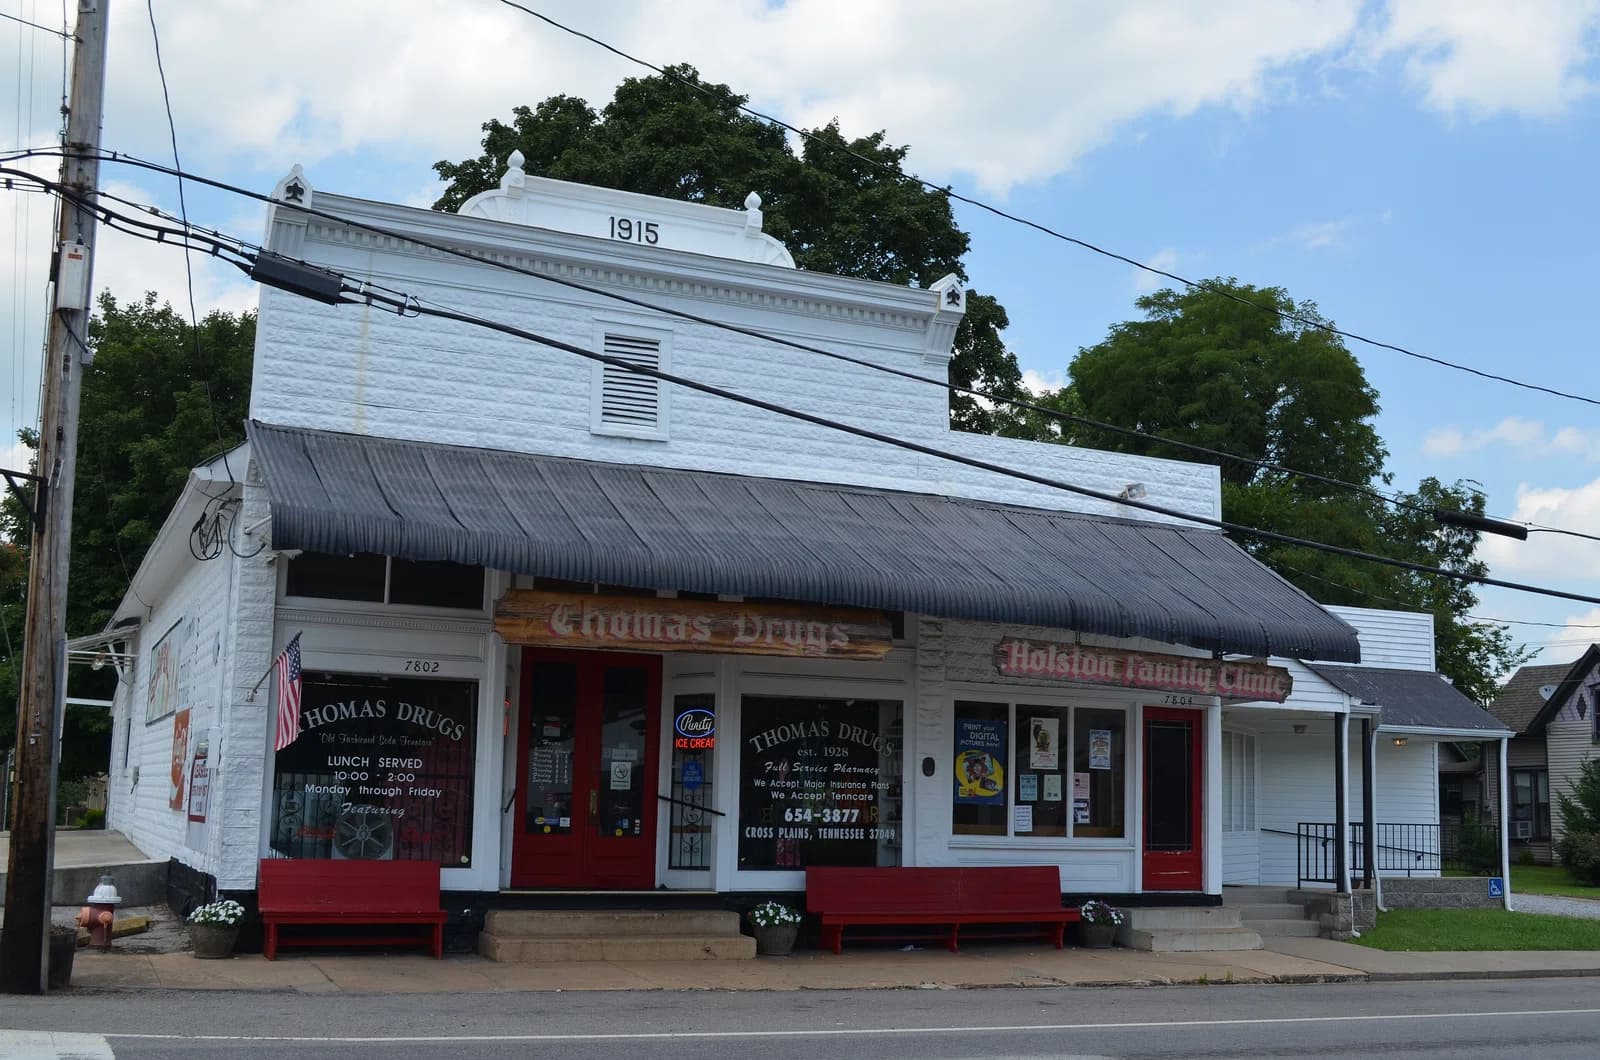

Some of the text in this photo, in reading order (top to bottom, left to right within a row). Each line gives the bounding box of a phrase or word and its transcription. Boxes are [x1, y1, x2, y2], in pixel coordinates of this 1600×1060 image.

[608, 216, 659, 244] 1915
[545, 602, 850, 655] Thomas Drugs
[405, 660, 440, 673] 7802
[1001, 642, 1287, 697] Holston Family Clinic
[1163, 694, 1194, 706] 7804
[397, 702, 465, 741] DRUGS
[680, 714, 713, 733] Purity
[963, 723, 983, 731] PRINT
[675, 738, 688, 747] ICE
[749, 720, 895, 757] THOMAS DRUGS
[970, 732, 1000, 742] DIGITAL
[824, 747, 849, 757] 1928
[327, 755, 423, 769] LUNCH SERVED
[764, 761, 881, 776] Full Service Pharmacy
[334, 770, 369, 781] 10:00
[387, 772, 415, 782] 2:00
[305, 783, 442, 798] Monday through Friday
[754, 779, 890, 790] We Accept Major Insurance Plans
[771, 791, 874, 802] We Accept Tenncare
[340, 802, 406, 818] Featuring
[784, 808, 860, 823] 654-3877
[745, 827, 896, 840] CROSS PLAINS, TENNESSEE 37049
